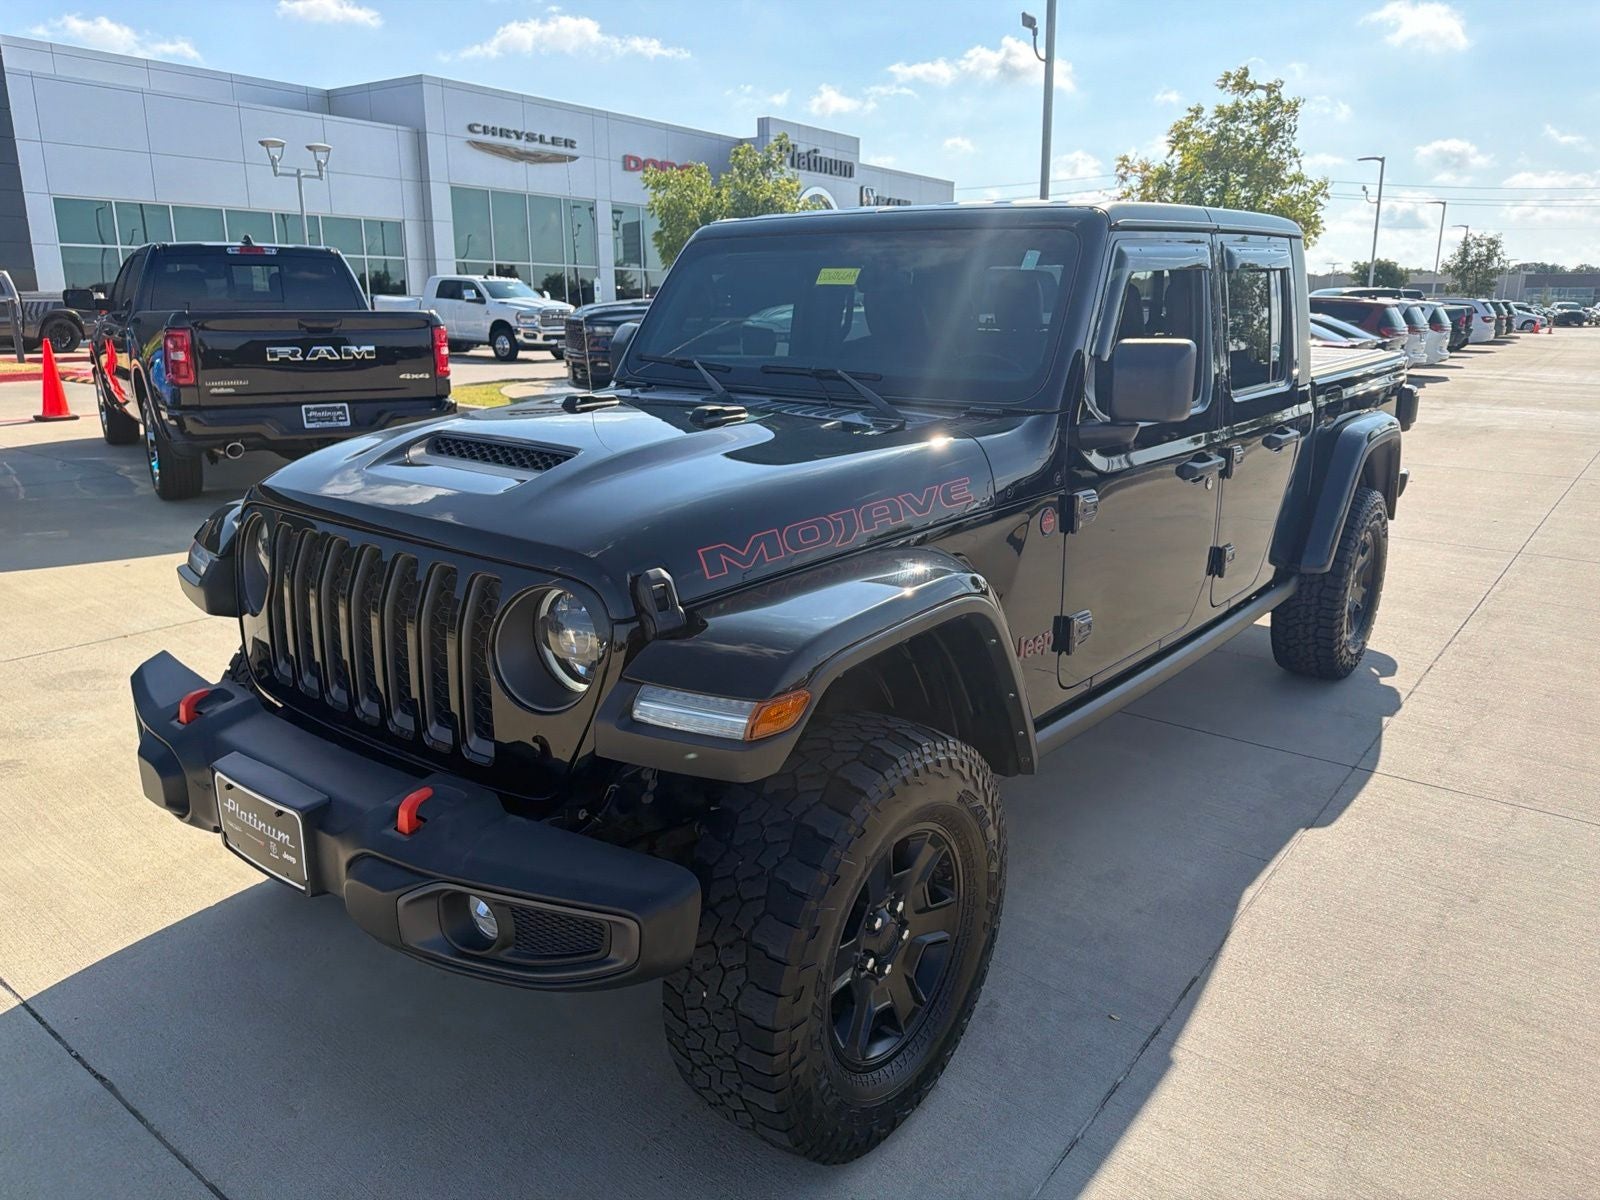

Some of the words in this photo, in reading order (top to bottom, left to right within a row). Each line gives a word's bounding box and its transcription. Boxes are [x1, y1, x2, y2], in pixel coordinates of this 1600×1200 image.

[467, 123, 577, 149] CHRYSLER
[266, 345, 376, 361] RAM
[698, 477, 974, 580] MOJAVE
[224, 798, 295, 848] Platinum
